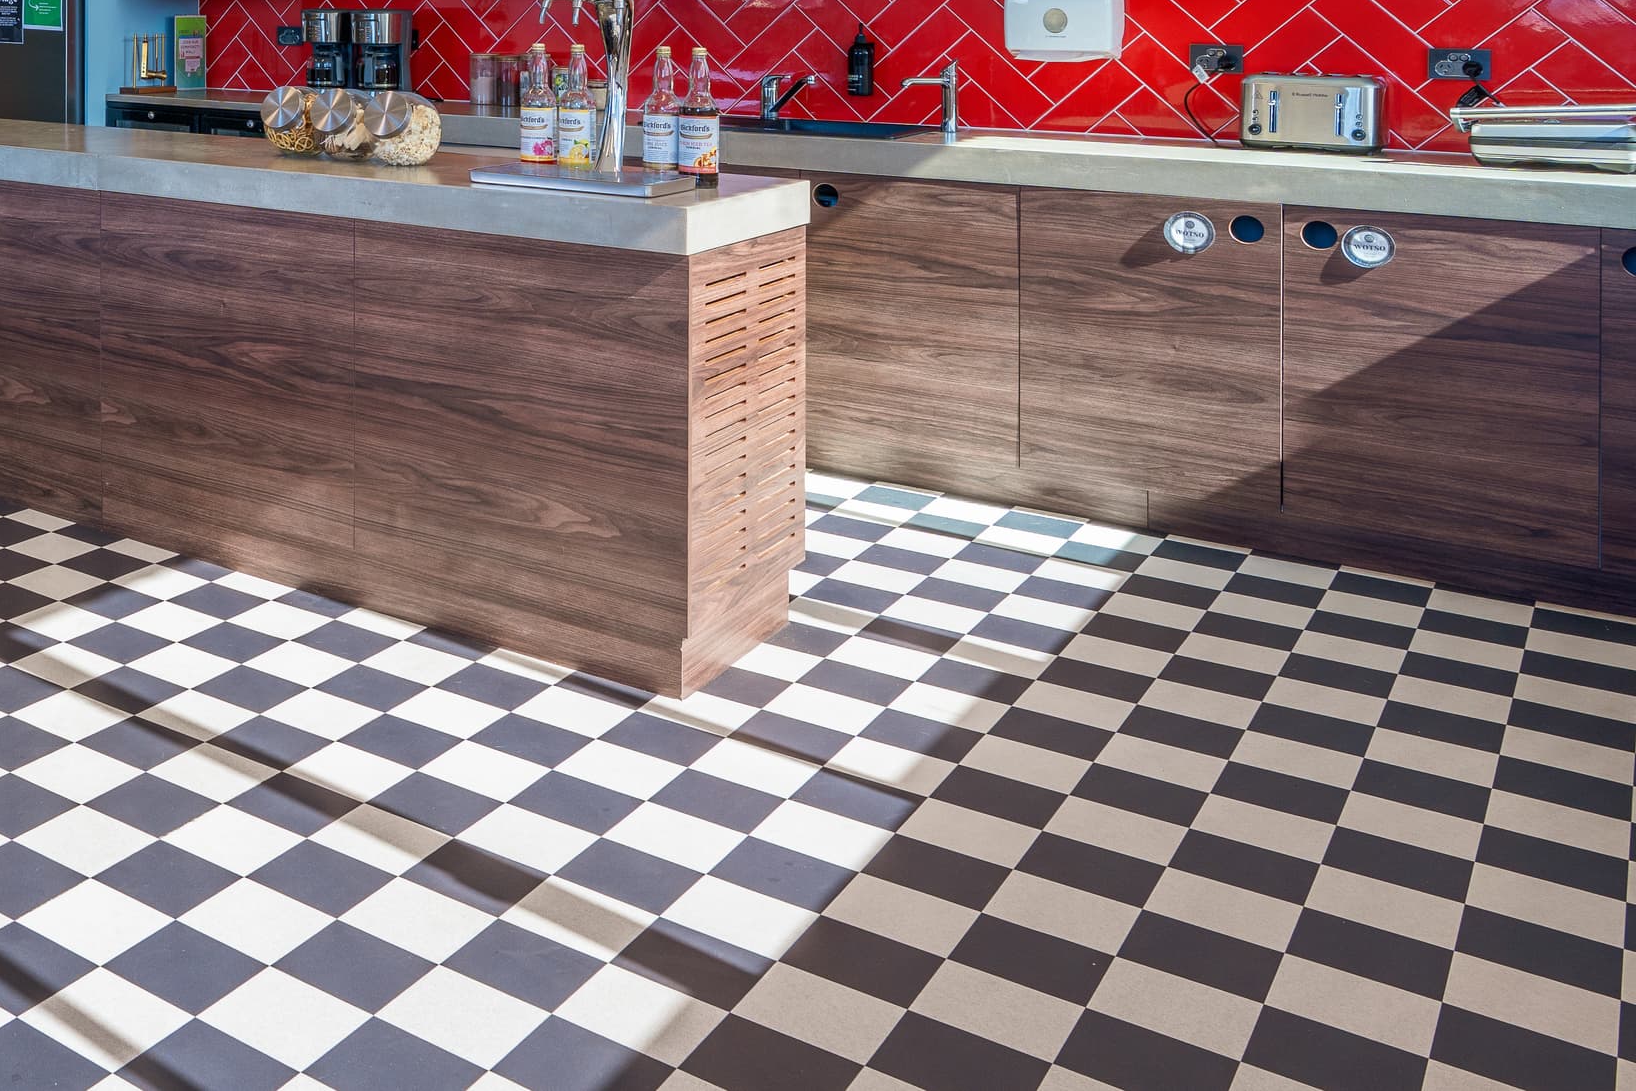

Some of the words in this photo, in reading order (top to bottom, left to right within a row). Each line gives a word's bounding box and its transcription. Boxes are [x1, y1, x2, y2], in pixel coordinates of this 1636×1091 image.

[680, 124, 711, 132] Bickford's
[1175, 229, 1205, 238] WOTSO
[1354, 244, 1386, 252] WOTSO
